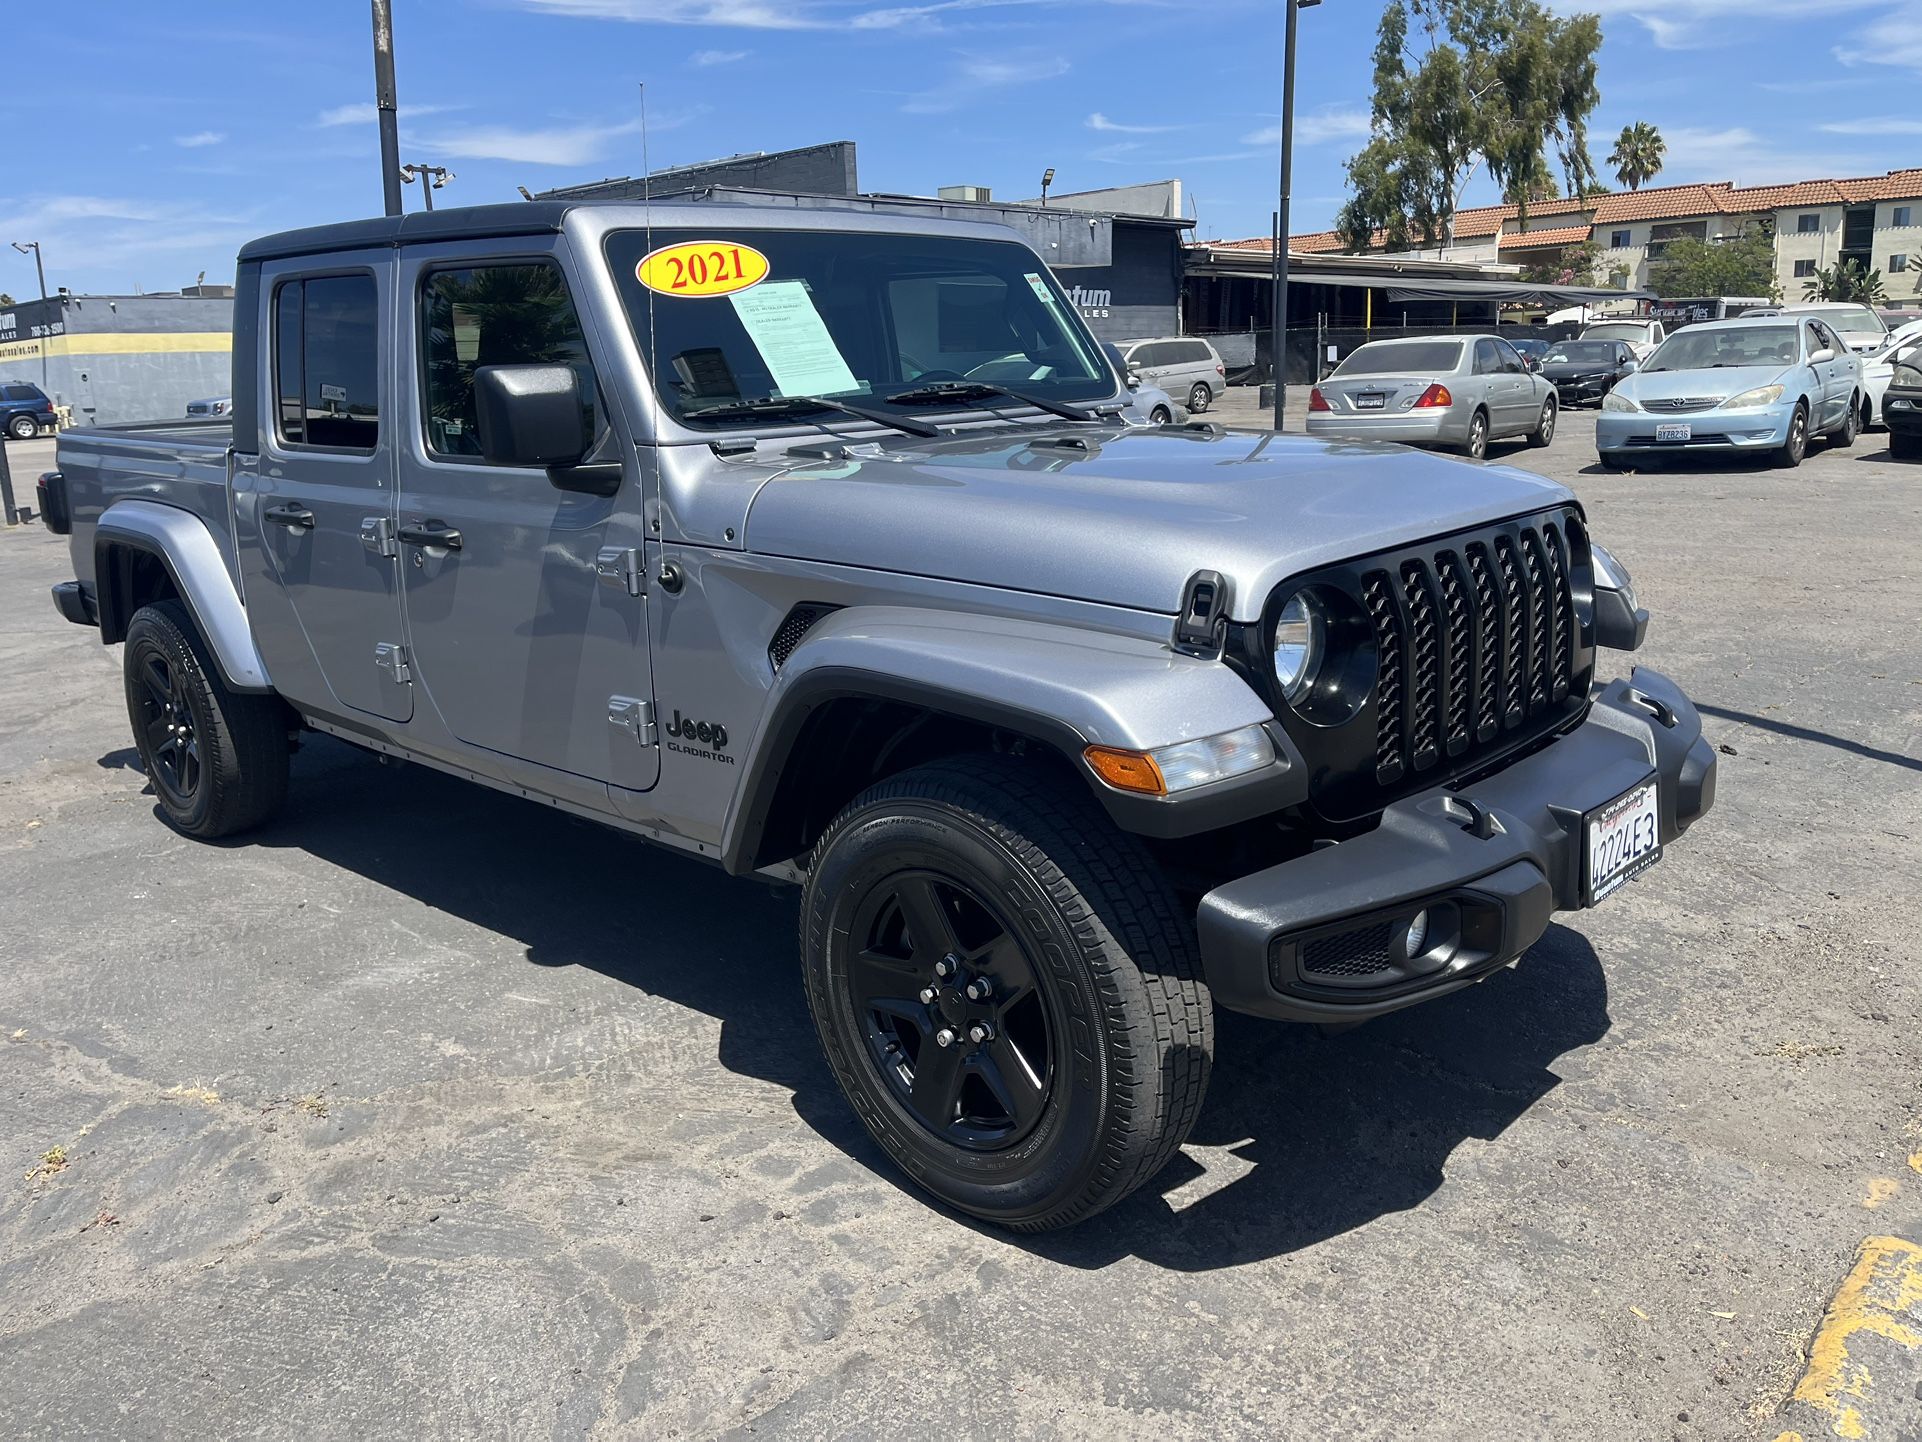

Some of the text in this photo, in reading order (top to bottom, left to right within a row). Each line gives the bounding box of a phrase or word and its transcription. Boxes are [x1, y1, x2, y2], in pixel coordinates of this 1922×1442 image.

[666, 248, 746, 289] 2021
[1084, 310, 1109, 318] LES
[666, 709, 728, 751] Jeep
[667, 742, 735, 765] GLADIATOR
[1592, 812, 1654, 887] 42224E3
[1625, 866, 1639, 878] AUTO
[1006, 877, 1094, 1090] COOPER
